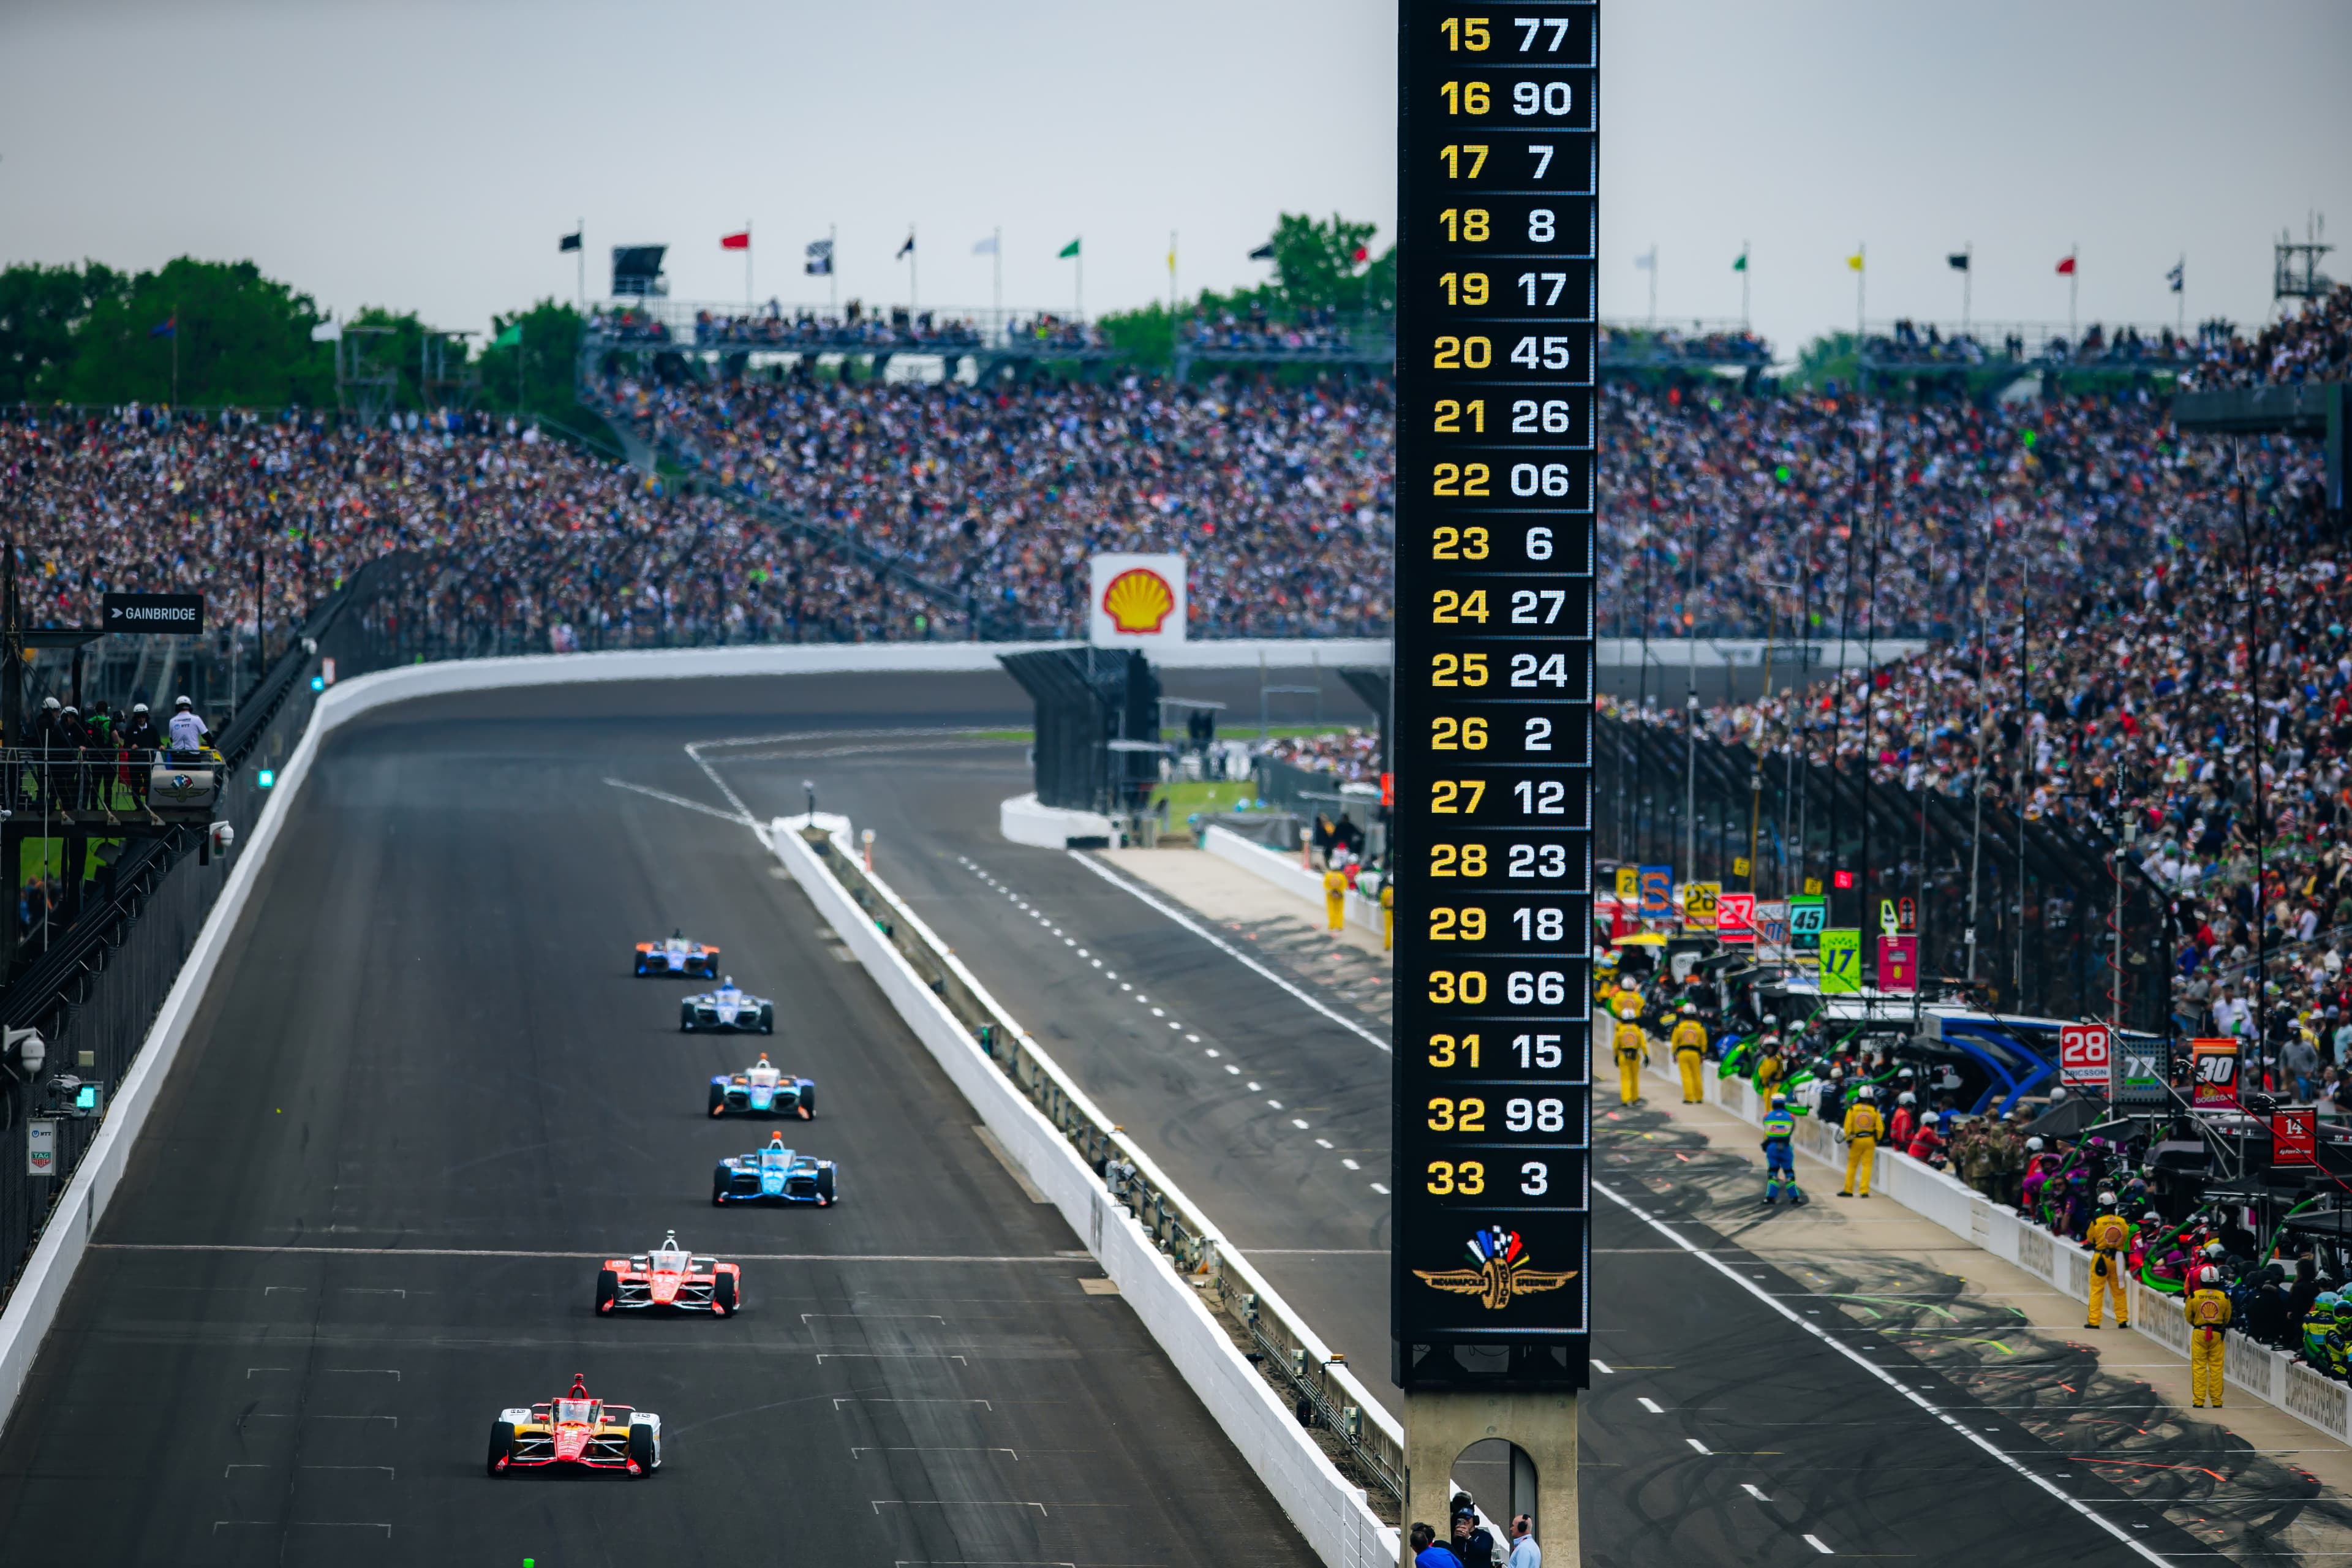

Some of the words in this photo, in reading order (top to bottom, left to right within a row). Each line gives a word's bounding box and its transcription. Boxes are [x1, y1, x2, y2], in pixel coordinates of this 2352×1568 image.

[1441, 18, 1490, 51] 15
[1514, 18, 1569, 51] 77
[1441, 81, 1490, 115] 16
[1513, 81, 1571, 116] 90
[1440, 145, 1489, 179] 17
[1528, 145, 1553, 179] 7
[1440, 208, 1490, 242] 18
[1528, 209, 1555, 243] 8
[1440, 272, 1489, 306] 19
[1518, 273, 1566, 306] 17
[1434, 336, 1491, 369] 20
[1510, 336, 1569, 369] 45
[1434, 399, 1485, 432] 21
[1512, 400, 1569, 433] 26
[1433, 462, 1490, 497] 22
[1511, 463, 1569, 497] 06
[1433, 526, 1490, 560] 23
[1526, 527, 1553, 560] 6
[126, 607, 195, 620] GAINBRIDGE
[1433, 589, 1490, 624] 24
[1512, 590, 1565, 624] 27
[1432, 653, 1488, 687] 25
[1510, 654, 1567, 687] 24
[1431, 717, 1488, 750] 26
[1525, 717, 1551, 750] 2
[1431, 780, 1486, 813] 27
[1514, 781, 1564, 814] 12
[1430, 844, 1487, 877] 28
[1509, 844, 1566, 877] 23
[1687, 889, 1717, 910] 26
[1718, 899, 1751, 924] 27
[1430, 907, 1487, 940] 29
[1513, 908, 1564, 941] 18
[1793, 910, 1821, 930] 45
[1826, 949, 1857, 973] 17
[1428, 970, 1487, 1005] 30
[1507, 971, 1564, 1005] 66
[1428, 1034, 1480, 1068] 31
[1512, 1035, 1562, 1068] 15
[2064, 1031, 2106, 1061] 28
[2125, 1057, 2156, 1078] 77
[2196, 1057, 2234, 1082] 30
[1428, 1098, 1485, 1132] 32
[1506, 1098, 1564, 1132] 98
[2195, 1093, 2233, 1104] DOGECON
[2285, 1119, 2302, 1134] 14
[32, 1158, 50, 1167] HEUER
[1427, 1161, 1485, 1195] 33
[1521, 1161, 1548, 1196] 3
